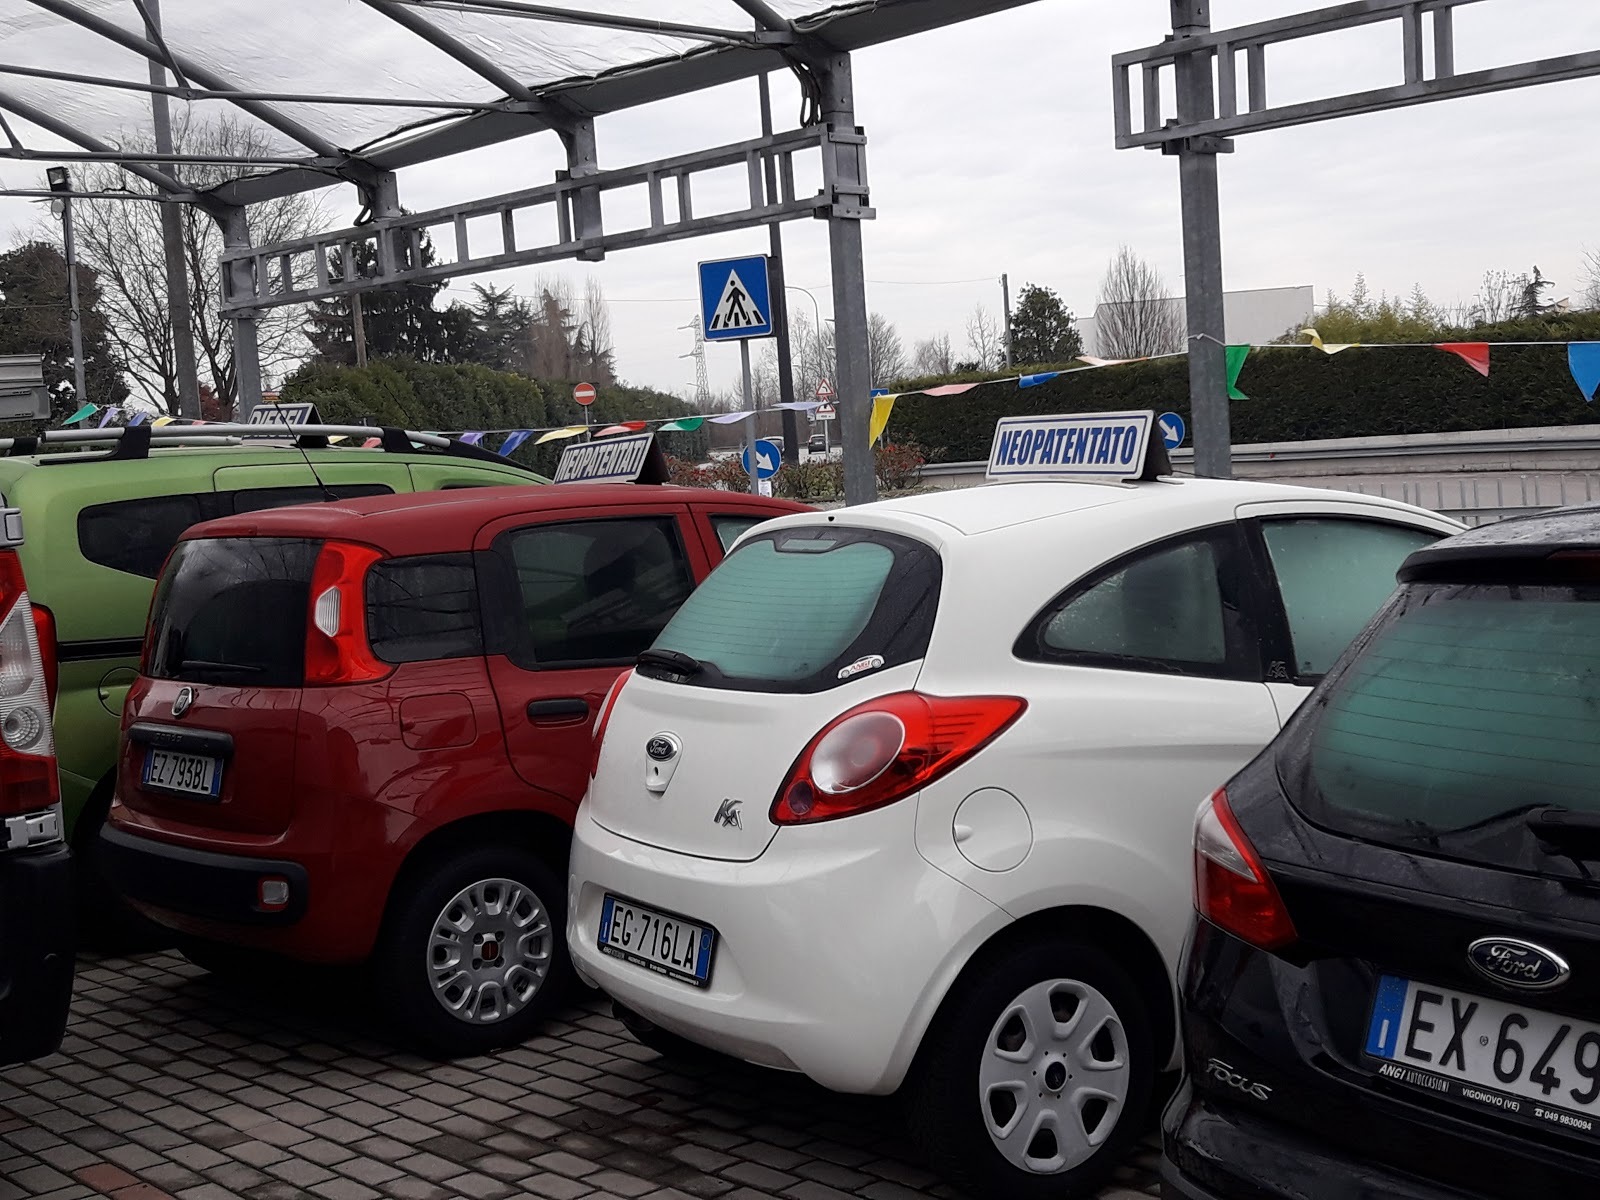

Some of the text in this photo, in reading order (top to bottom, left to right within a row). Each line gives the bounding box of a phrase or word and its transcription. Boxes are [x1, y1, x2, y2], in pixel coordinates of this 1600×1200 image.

[556, 440, 647, 481] NEOPATENTATI
[996, 426, 1138, 465] NEOPATENTATO
[650, 739, 668, 755] Ford
[150, 752, 168, 784] EZ
[169, 756, 209, 791] 793BL
[610, 905, 634, 946] EG
[637, 913, 695, 970] 716LA
[1486, 944, 1541, 979] Ford
[1404, 990, 1479, 1071] EX
[1379, 1063, 1592, 1131] ANGI AUTOCCASIONI VIGONOVO (VE) 049 9830094
